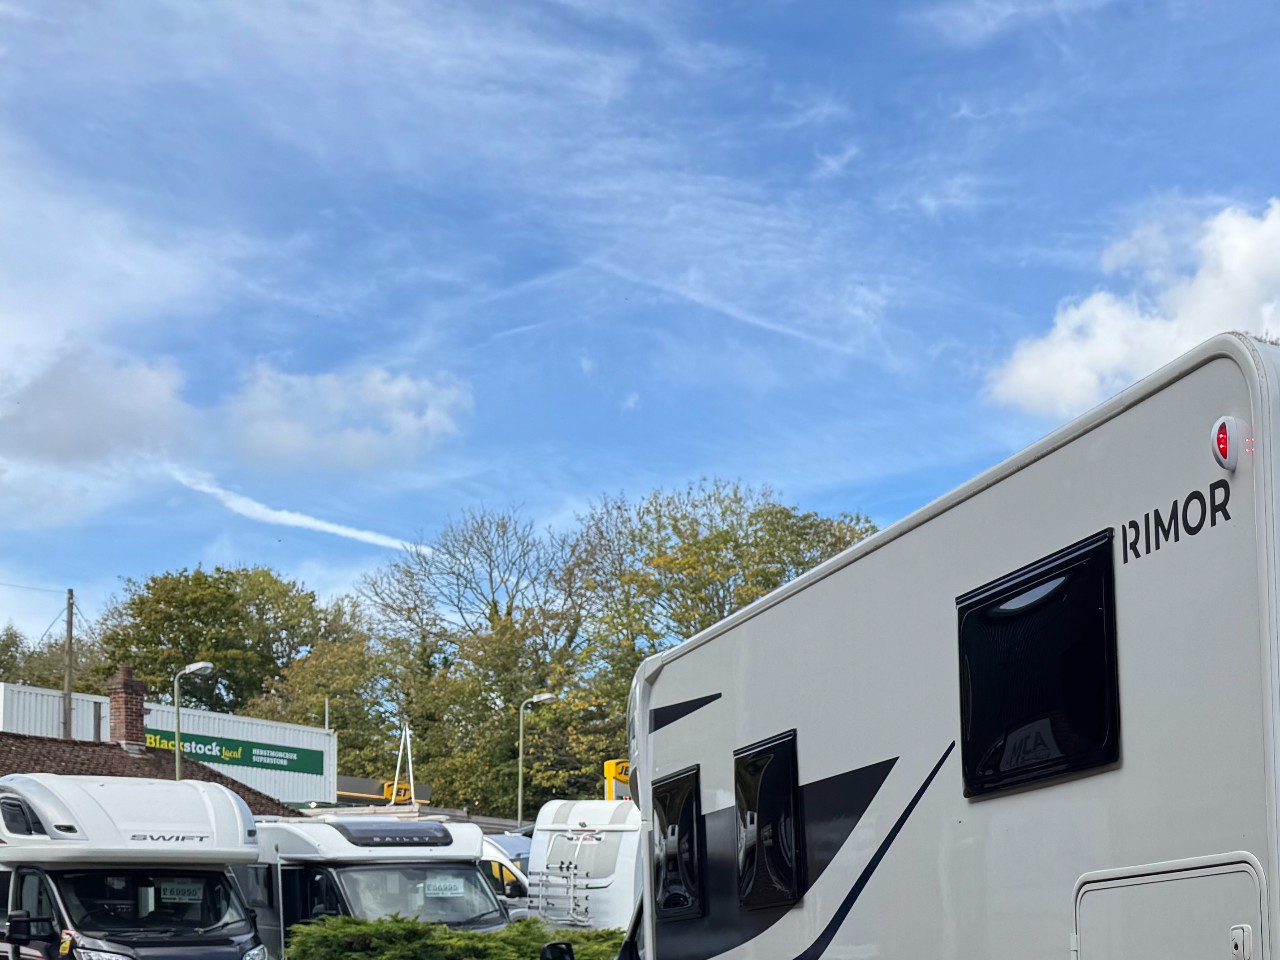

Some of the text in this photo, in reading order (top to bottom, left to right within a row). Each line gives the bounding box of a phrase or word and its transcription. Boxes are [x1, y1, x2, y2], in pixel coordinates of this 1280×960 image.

[1121, 478, 1232, 565] RIMOR
[252, 755, 288, 766] SUPERSTORE
[618, 765, 629, 776] JE
[130, 834, 209, 842] SWIFT
